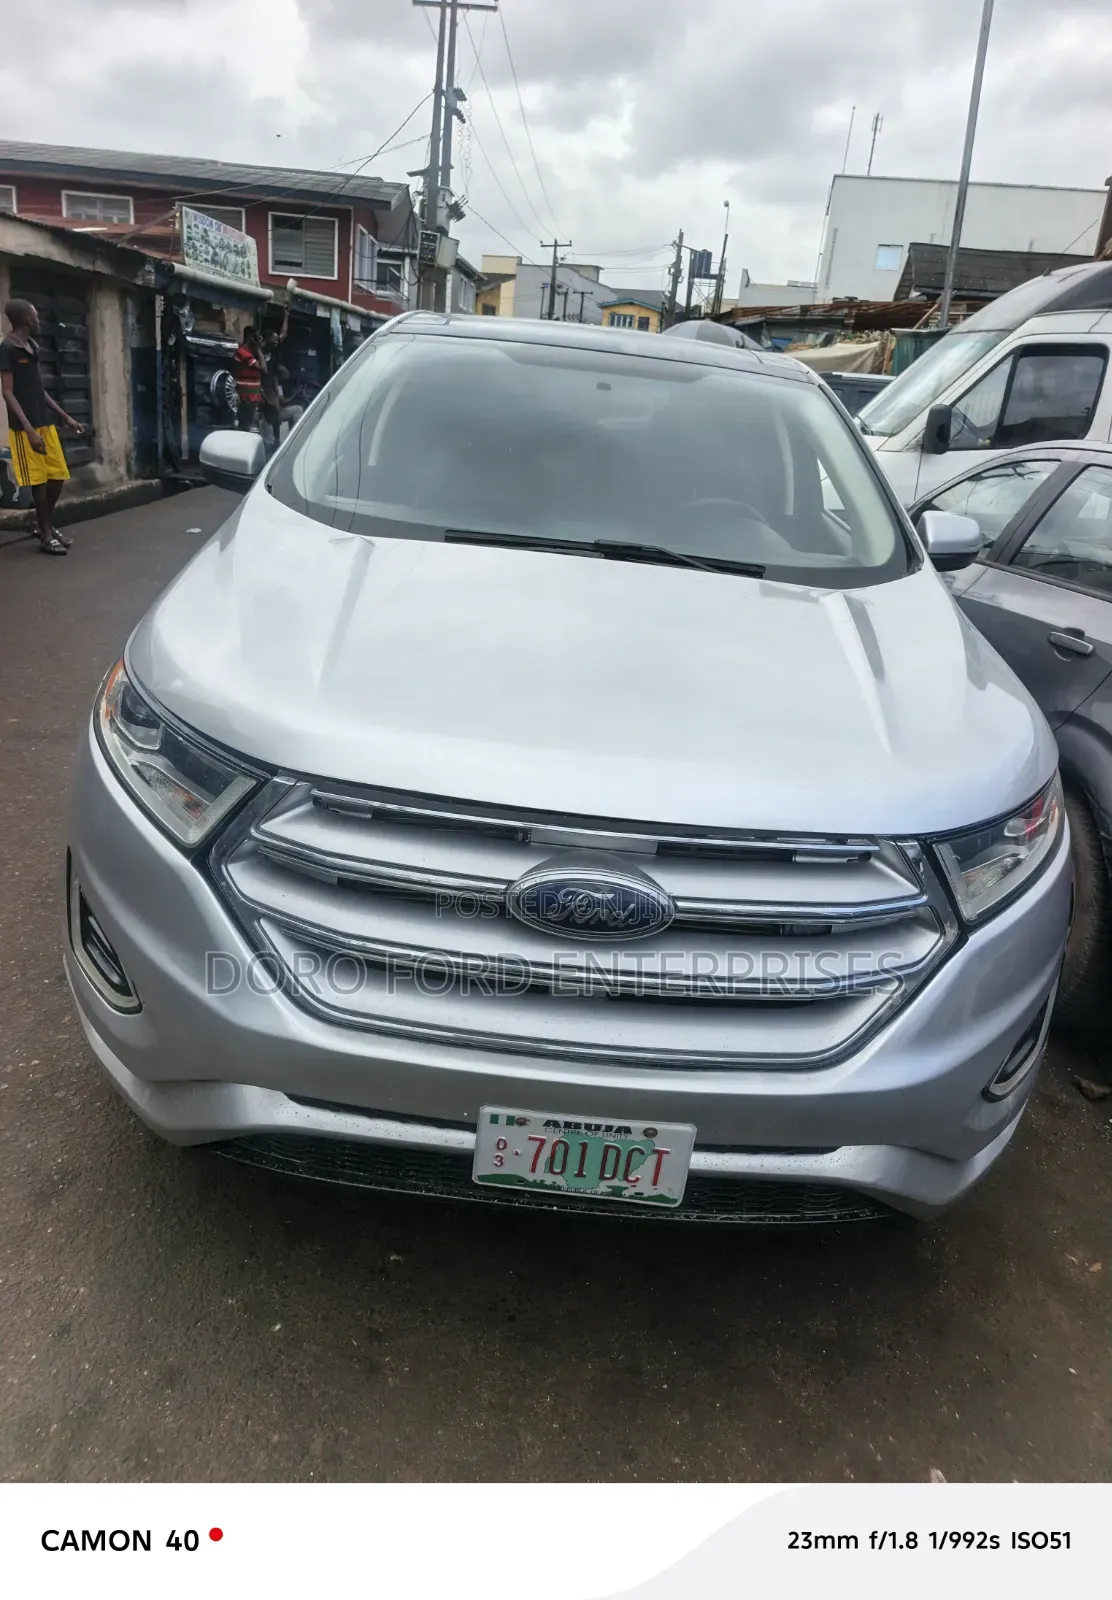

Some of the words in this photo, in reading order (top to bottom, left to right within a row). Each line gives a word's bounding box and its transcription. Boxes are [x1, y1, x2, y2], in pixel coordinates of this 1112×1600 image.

[549, 887, 636, 928] Ford
[542, 1119, 633, 1134] ABUJA
[544, 1127, 582, 1137] CENTRE
[602, 1131, 629, 1139] UNITY
[528, 1135, 671, 1187] 701DCT
